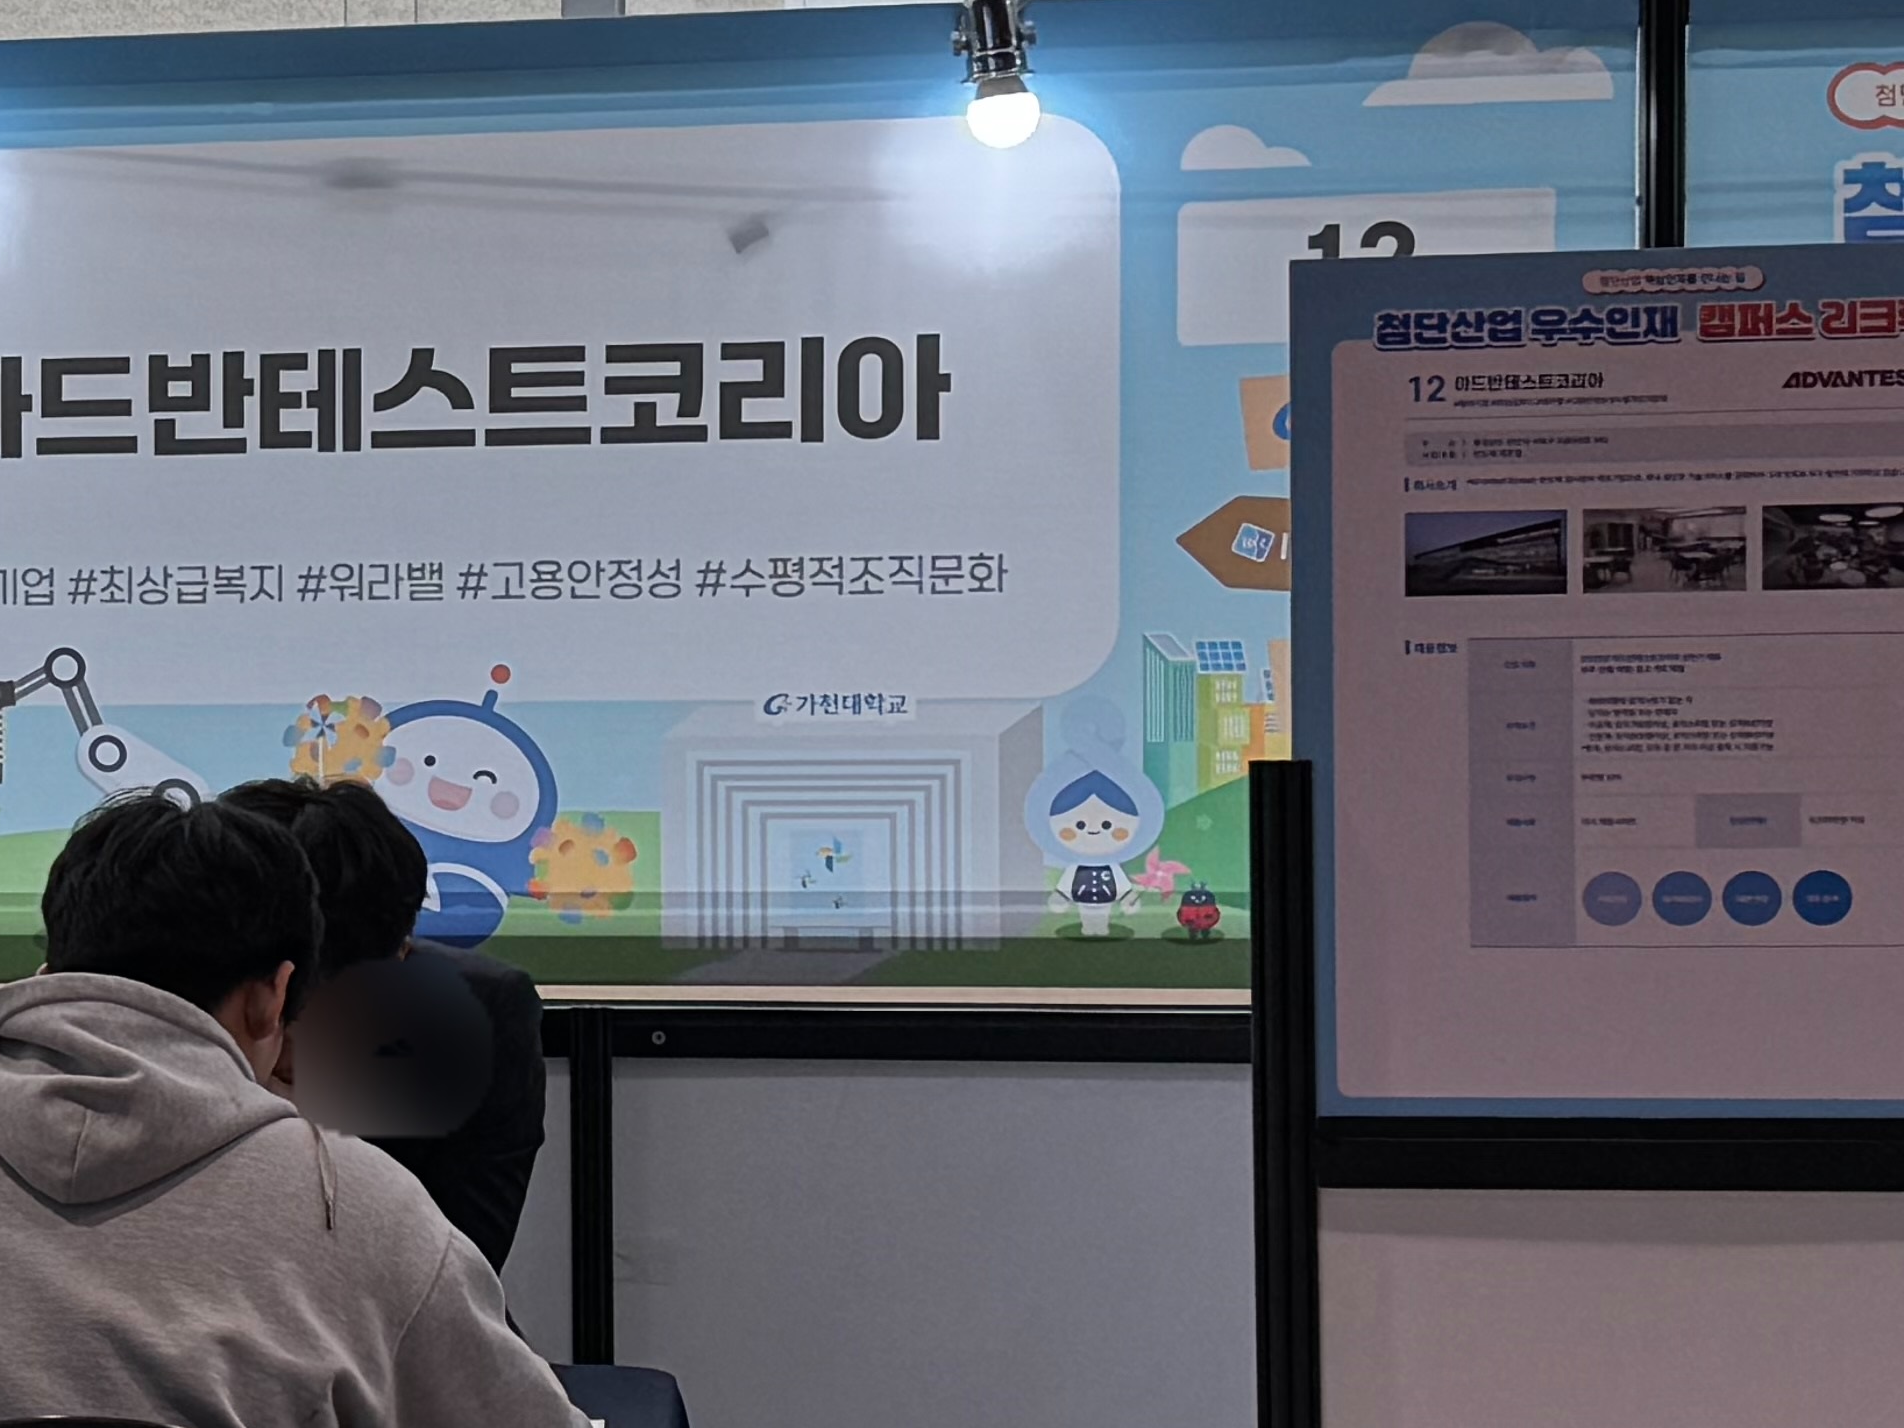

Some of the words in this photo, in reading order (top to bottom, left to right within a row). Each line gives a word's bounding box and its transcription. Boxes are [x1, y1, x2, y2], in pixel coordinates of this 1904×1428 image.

[1875, 84, 1904, 108] 첨
[1376, 309, 1524, 345] 첨단산업
[1529, 305, 1679, 342] 우수인재
[1699, 300, 1814, 338] 캠퍼스
[1819, 297, 1904, 335] 리크
[1408, 375, 1446, 402] 12
[68, 565, 284, 605] #최상급복지
[297, 562, 444, 602] #워라밸
[456, 559, 682, 600] #고용안정성
[696, 553, 1008, 598] #수평적조직문화
[796, 693, 908, 716] 가천대학교
